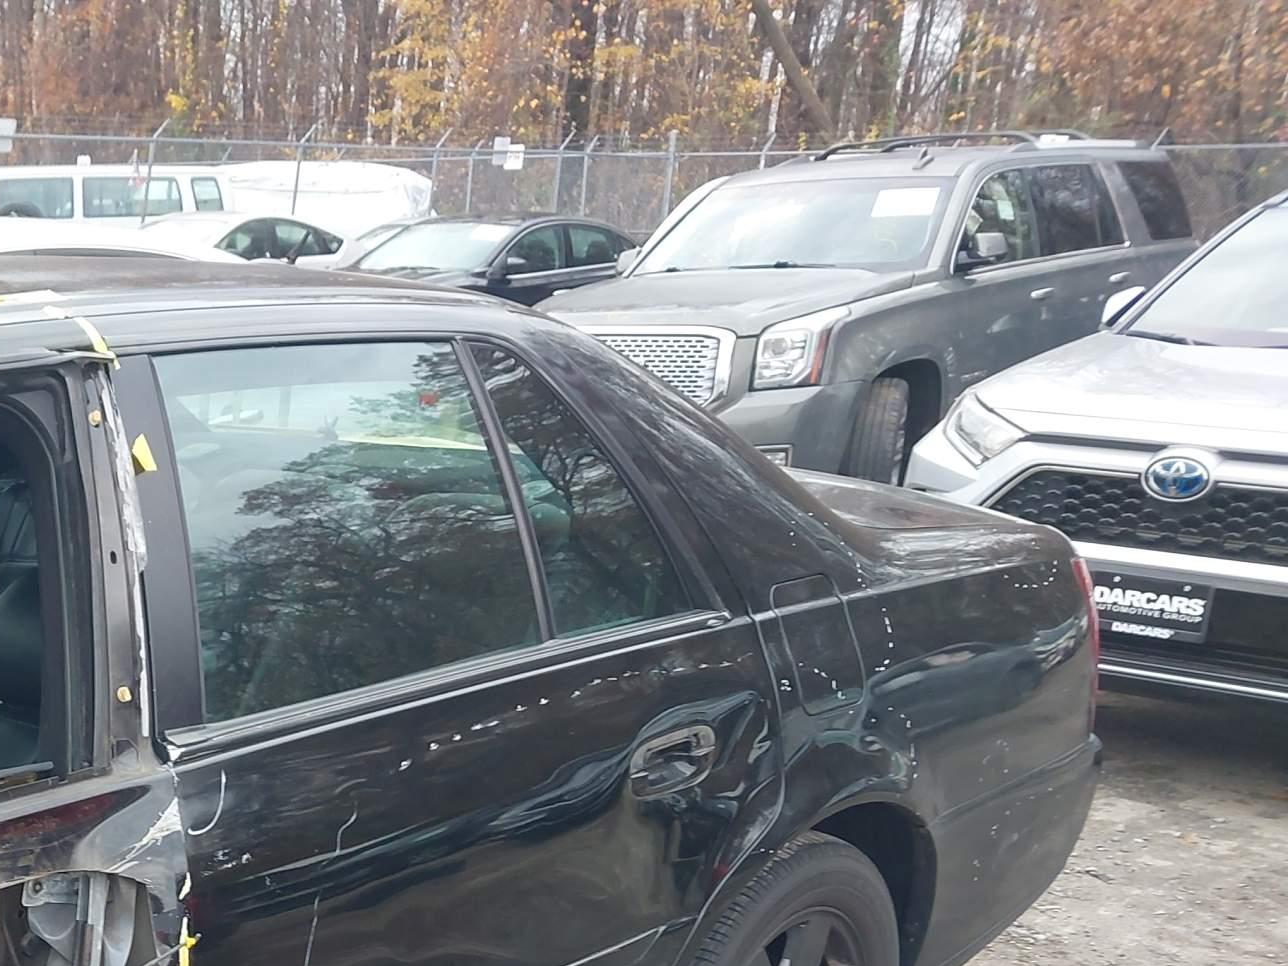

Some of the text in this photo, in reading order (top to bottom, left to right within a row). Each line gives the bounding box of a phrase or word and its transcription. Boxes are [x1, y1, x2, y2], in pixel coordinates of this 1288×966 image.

[1093, 586, 1207, 615] DARCARS
[1162, 611, 1203, 624] GROUP
[1111, 621, 1176, 640] DARCARS
